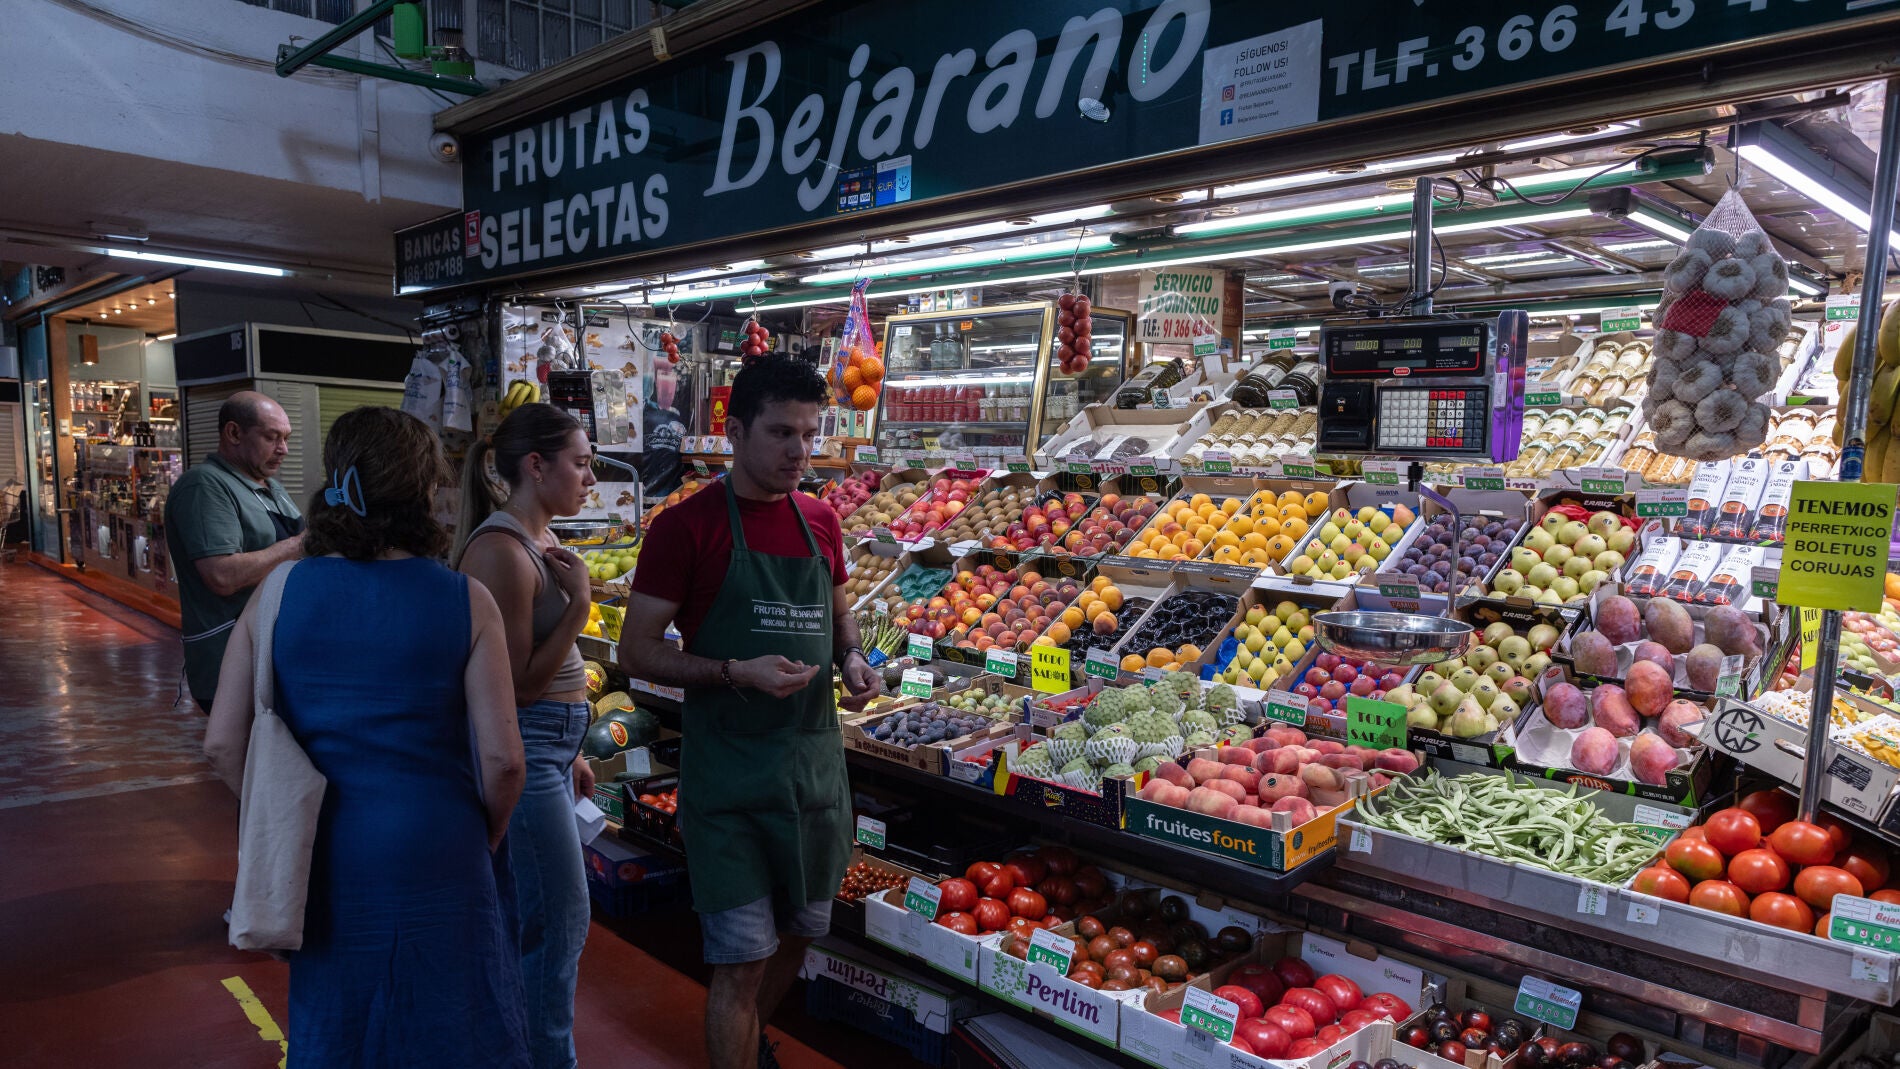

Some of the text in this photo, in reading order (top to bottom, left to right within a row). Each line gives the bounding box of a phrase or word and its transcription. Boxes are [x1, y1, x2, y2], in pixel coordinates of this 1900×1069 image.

[1328, 37, 1439, 96] TLF.
[1452, 6, 1578, 71] 366
[1233, 56, 1289, 78] FOLLOW US!
[704, 0, 1212, 212] Bejarano
[492, 88, 650, 193] FRUTAS
[480, 173, 669, 270] SELECTAS
[404, 226, 460, 261] BANCAS
[1153, 273, 1213, 293] SERVICIO
[1156, 295, 1219, 315] DOMICILIO
[1163, 319, 1172, 338] 91
[1174, 320, 1190, 338] 366
[1797, 499, 1889, 518] TENEMOS
[1795, 540, 1877, 557] BOLETUS
[1790, 560, 1875, 578] CORUJAS
[754, 605, 824, 618] FRUTAS BEJARANO
[760, 618, 787, 628] MERCADO
[797, 621, 804, 629] LA
[1038, 653, 1065, 666] TODO
[1356, 712, 1397, 728] TODO
[1146, 813, 1257, 855] fruitesfont
[826, 957, 887, 998] Perlim
[1025, 973, 1101, 1025] Perlim
